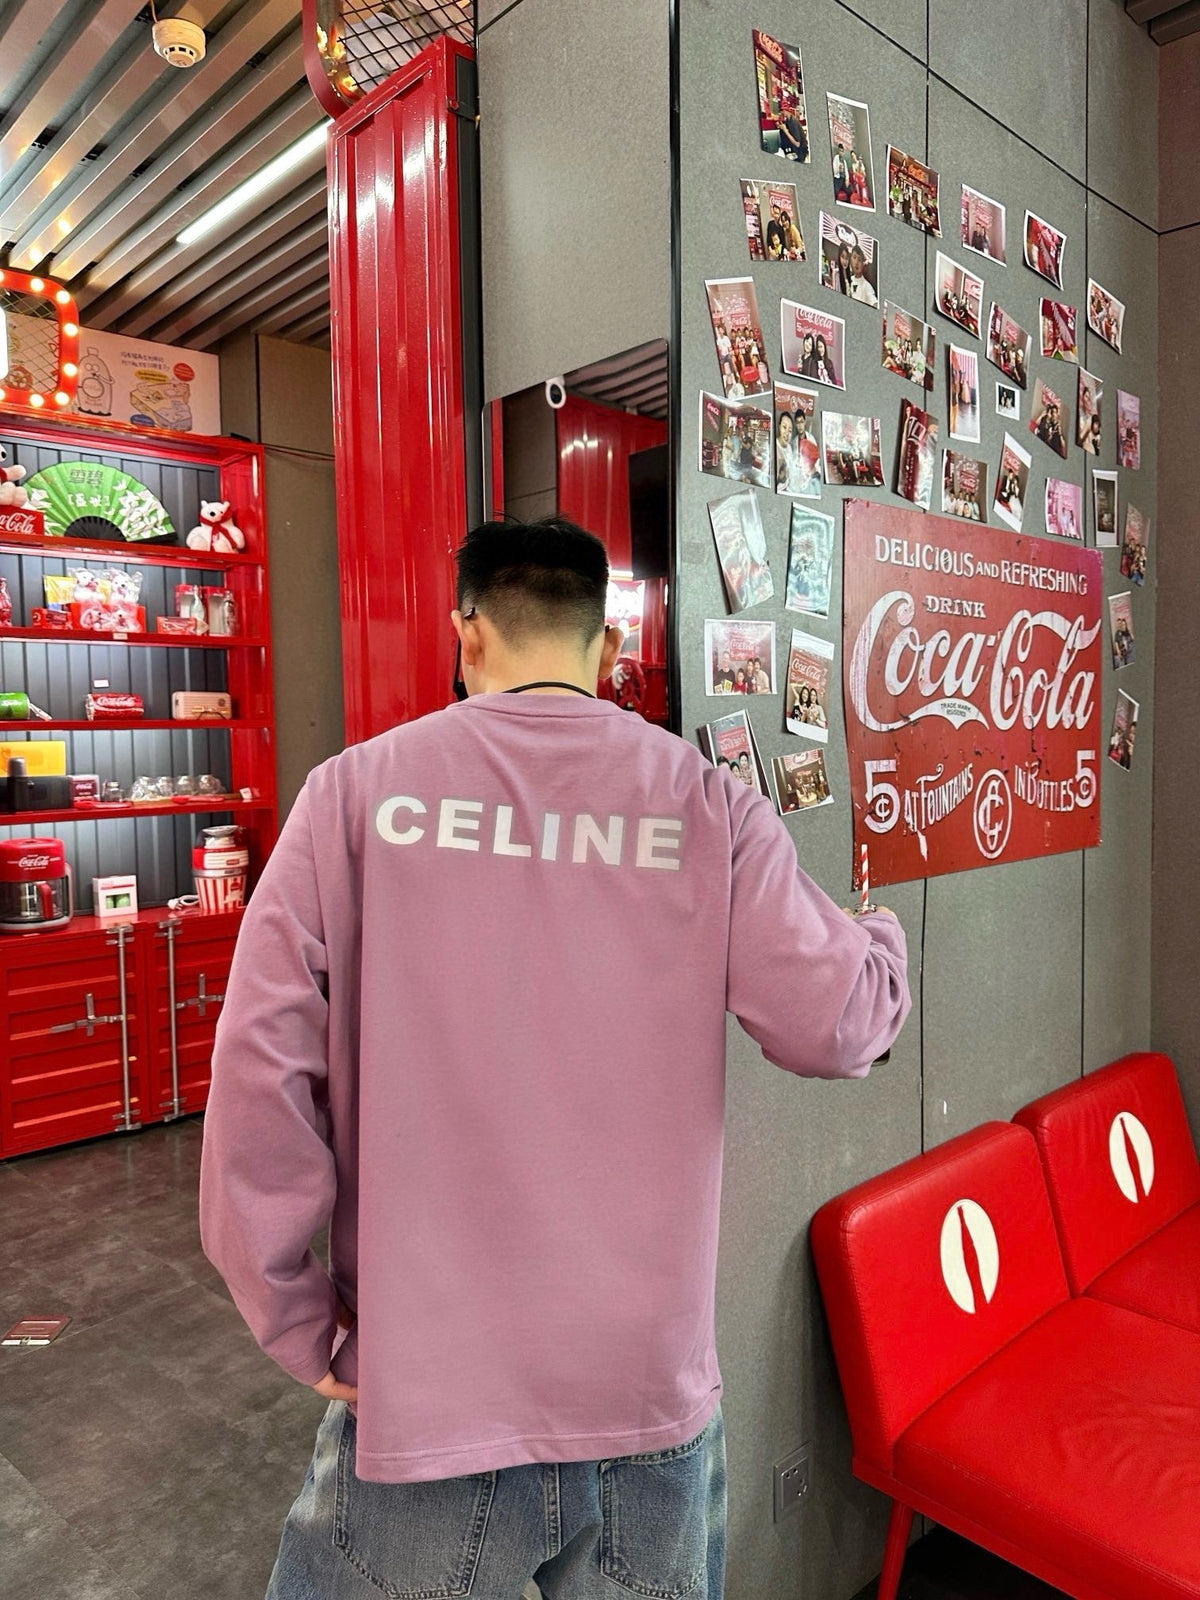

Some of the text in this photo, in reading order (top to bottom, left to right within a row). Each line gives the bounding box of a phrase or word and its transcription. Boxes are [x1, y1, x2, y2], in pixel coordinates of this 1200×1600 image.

[875, 534, 1088, 595] DELICIOUS AND REFRESHING
[925, 595, 986, 618] DRINK
[849, 590, 1101, 731] Coca-Cola
[903, 789, 920, 832] AT
[916, 763, 974, 830] FOUNTAINS
[1013, 763, 1027, 802] IN
[1025, 761, 1075, 813] BOTTLES
[375, 795, 683, 870] CELINE
